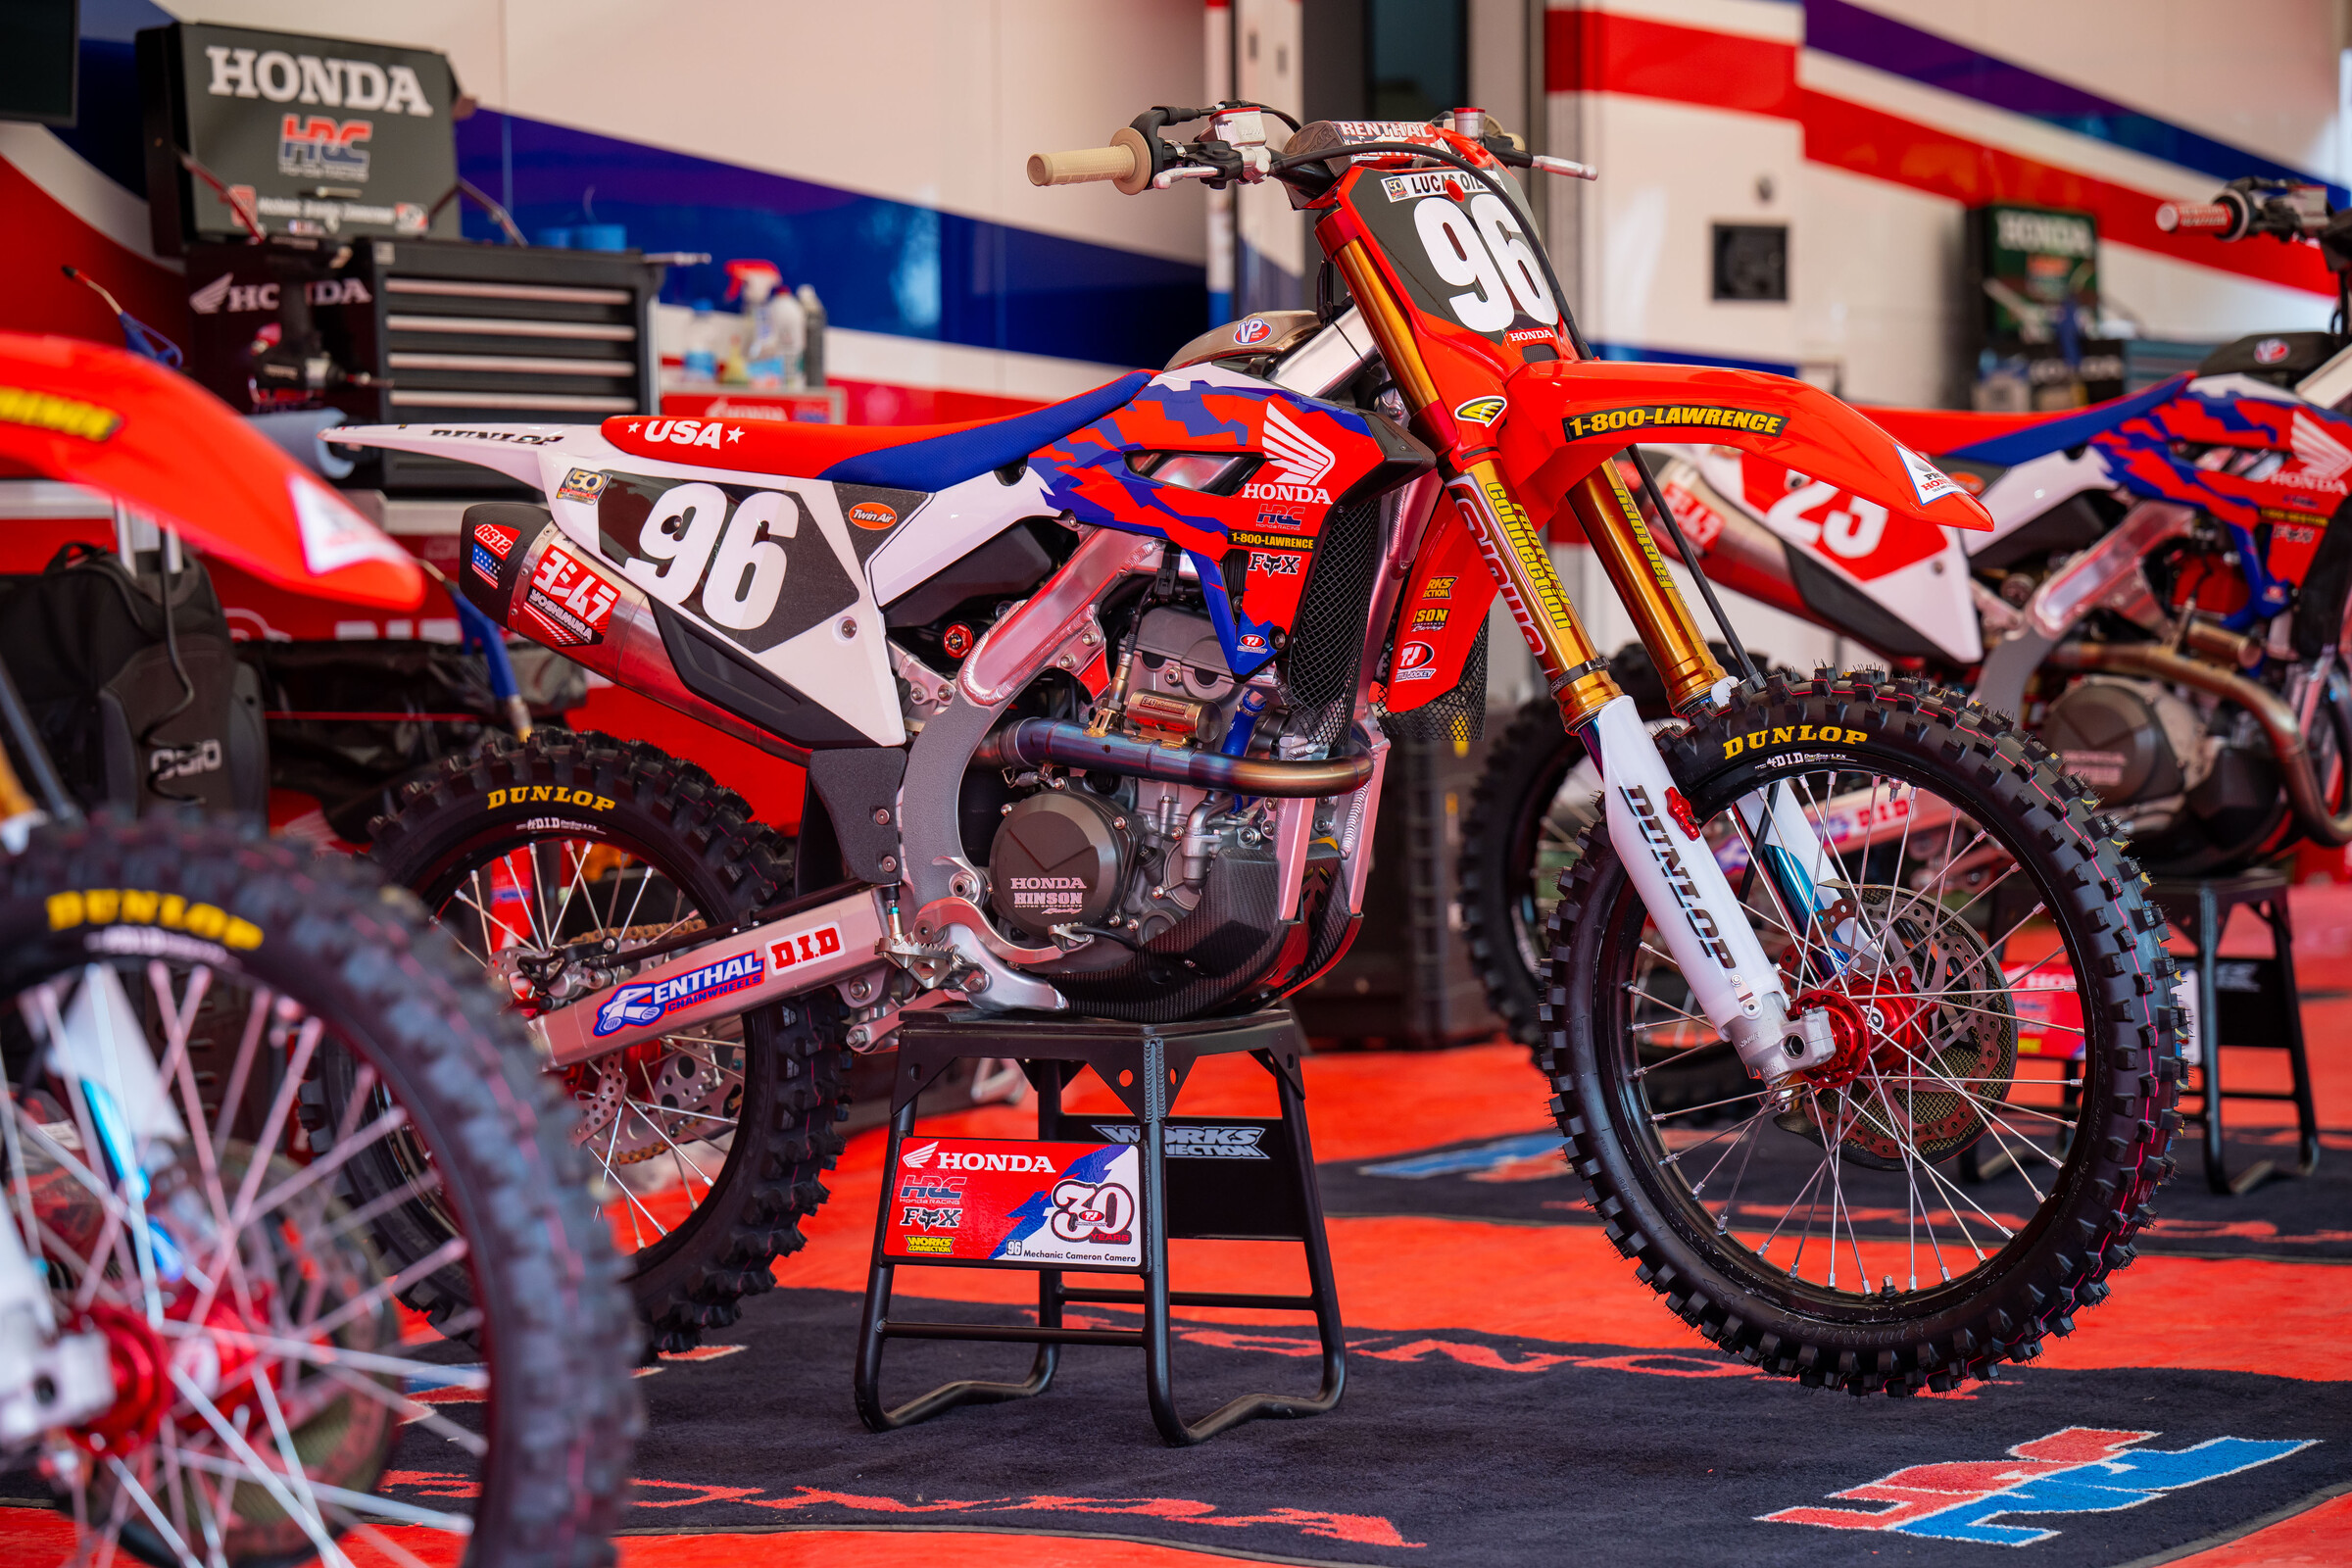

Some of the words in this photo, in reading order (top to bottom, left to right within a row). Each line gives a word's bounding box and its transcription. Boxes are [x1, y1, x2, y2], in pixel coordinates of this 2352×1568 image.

[205, 45, 433, 118] HONDA
[1340, 122, 1435, 138] RENTHAL
[1413, 193, 1559, 333] 96
[1240, 318, 1264, 344] VP
[1510, 328, 1554, 342] HONDA
[644, 419, 723, 450] USA
[1568, 409, 1783, 437] 1-800-LAWRENCE
[568, 469, 603, 492] 50
[1242, 483, 1334, 506] HONDA
[853, 508, 878, 522] Twin
[876, 513, 895, 524] Air
[1256, 503, 1306, 526] HRC
[1231, 532, 1314, 550] 1-800-LAWRENCE
[1613, 488, 1676, 589] Factory
[624, 482, 800, 631] 96
[1485, 481, 1573, 630] Connection
[533, 549, 617, 624] ヨシムラ
[531, 588, 593, 642] YOSHIMURA
[1722, 724, 1869, 760] DUNLOP
[486, 785, 616, 812] DUNLOP
[1009, 877, 1088, 890] HONDA
[1618, 783, 1738, 970] DUNLOP
[1013, 892, 1083, 905] HINSON
[45, 889, 265, 952] DUNLOP
[770, 926, 842, 970] D.I.D
[667, 974, 763, 1013] CHAINWHEELS
[937, 1152, 1056, 1174] HONDA
[900, 1174, 968, 1200] HRC
[1051, 1179, 1136, 1244] 30
[906, 1236, 954, 1247] WORKS
[907, 1245, 953, 1253] CONNECTION
[1090, 1233, 1131, 1242] YEARS
[1006, 1240, 1023, 1256] 96
[1023, 1250, 1064, 1259] Mechanic:
[1065, 1251, 1102, 1261] Cameron
[1103, 1253, 1137, 1263] Camera
